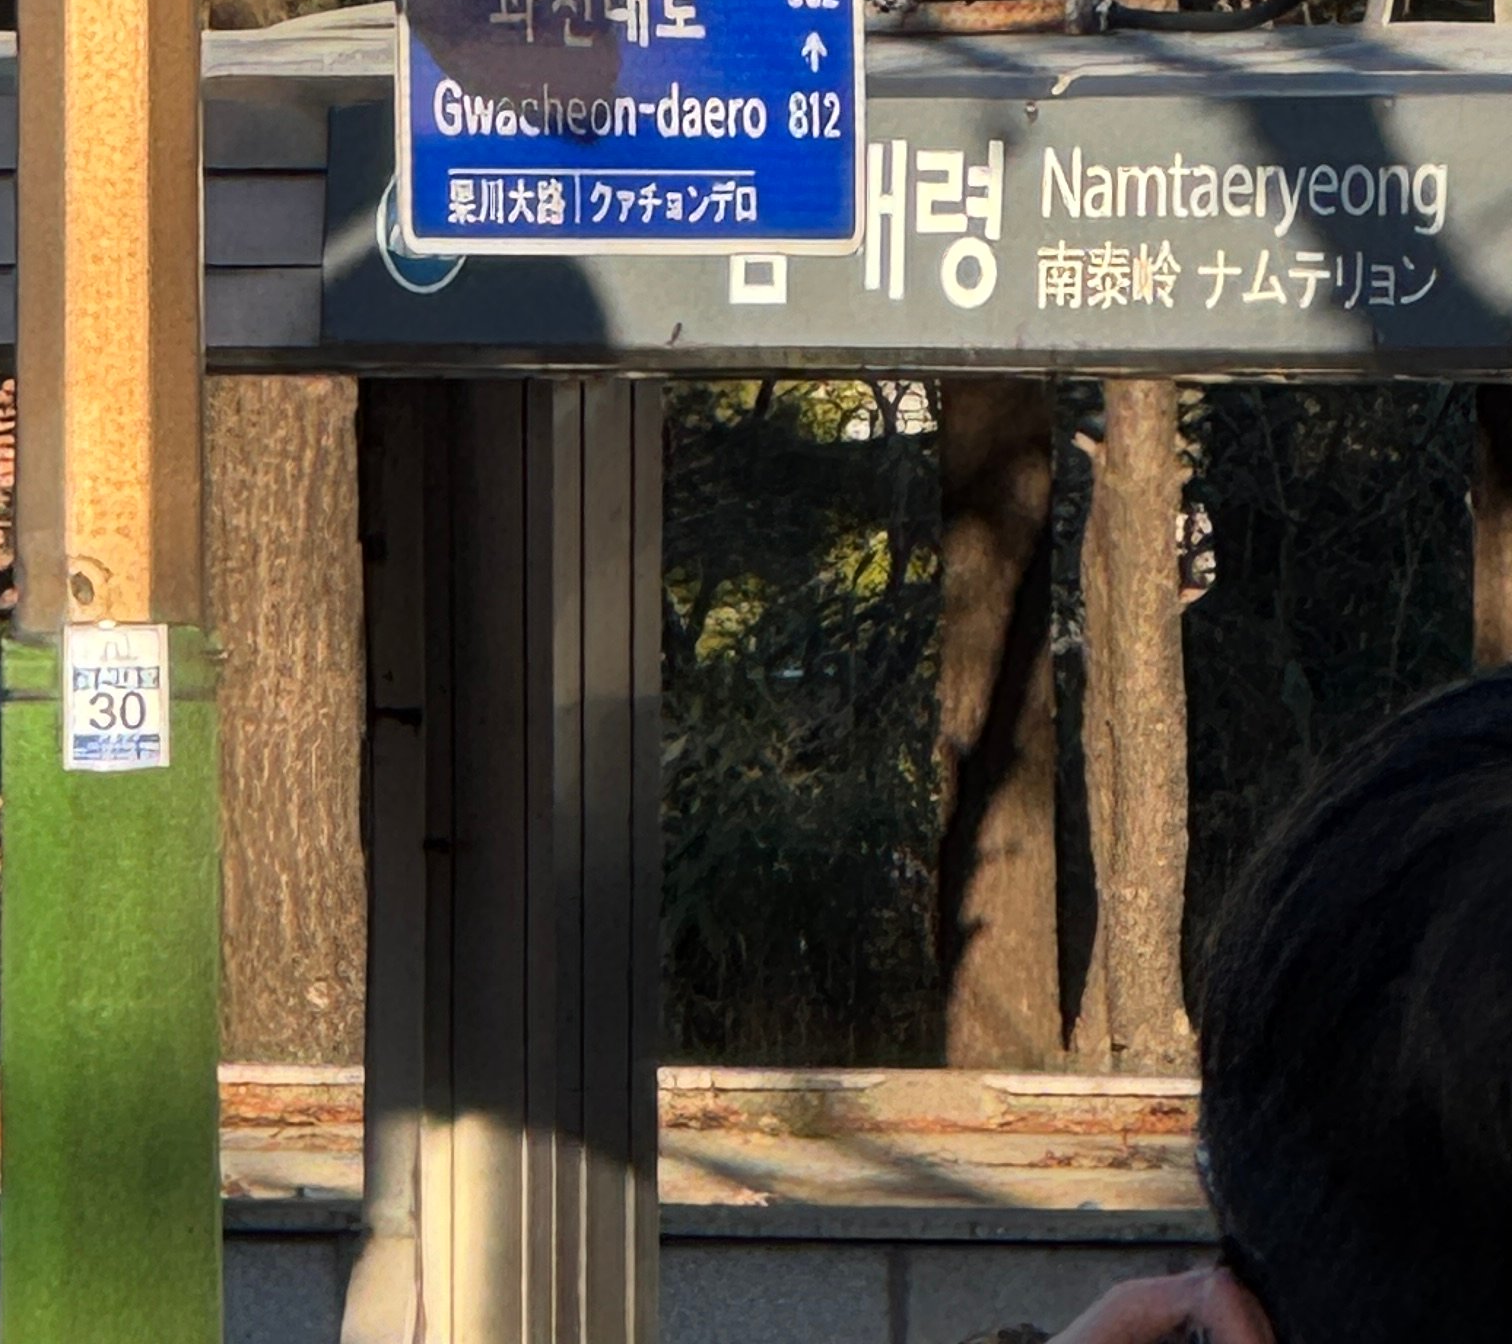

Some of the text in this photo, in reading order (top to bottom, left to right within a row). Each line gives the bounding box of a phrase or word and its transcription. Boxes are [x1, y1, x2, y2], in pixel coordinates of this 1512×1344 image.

[433, 78, 769, 139] Gwacheon-daero
[787, 90, 842, 140] 812
[589, 180, 758, 223] クァチョンデロ
[1040, 146, 1449, 238] Namtaeryeong
[1036, 239, 1438, 310] 南泰岭 ナムテリョン
[88, 690, 147, 731] 30
